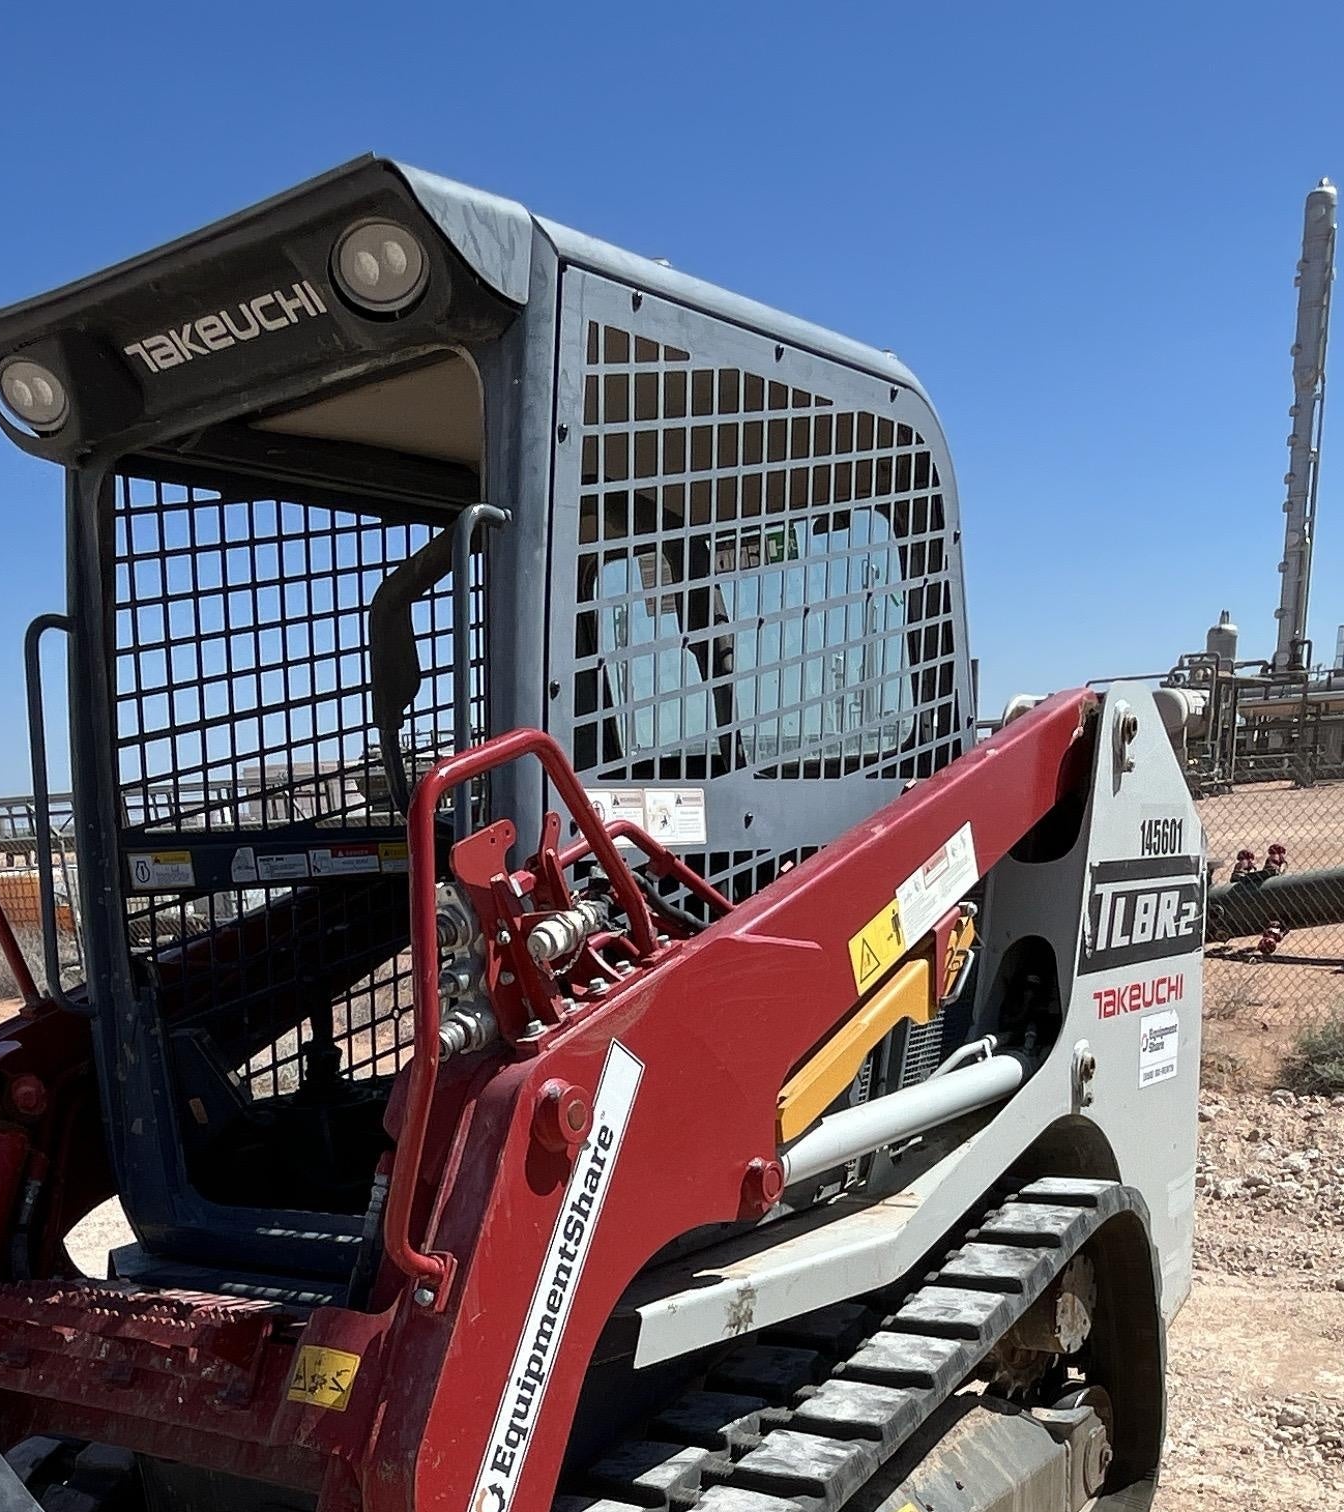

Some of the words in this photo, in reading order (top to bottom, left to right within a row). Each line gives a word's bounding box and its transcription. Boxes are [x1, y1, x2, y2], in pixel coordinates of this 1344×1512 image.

[123, 279, 328, 374] TAKEUCHI
[1140, 817, 1184, 857] 145601
[1092, 973, 1184, 1020] TAKEUCHI
[489, 1123, 616, 1480] EquipmentShare
